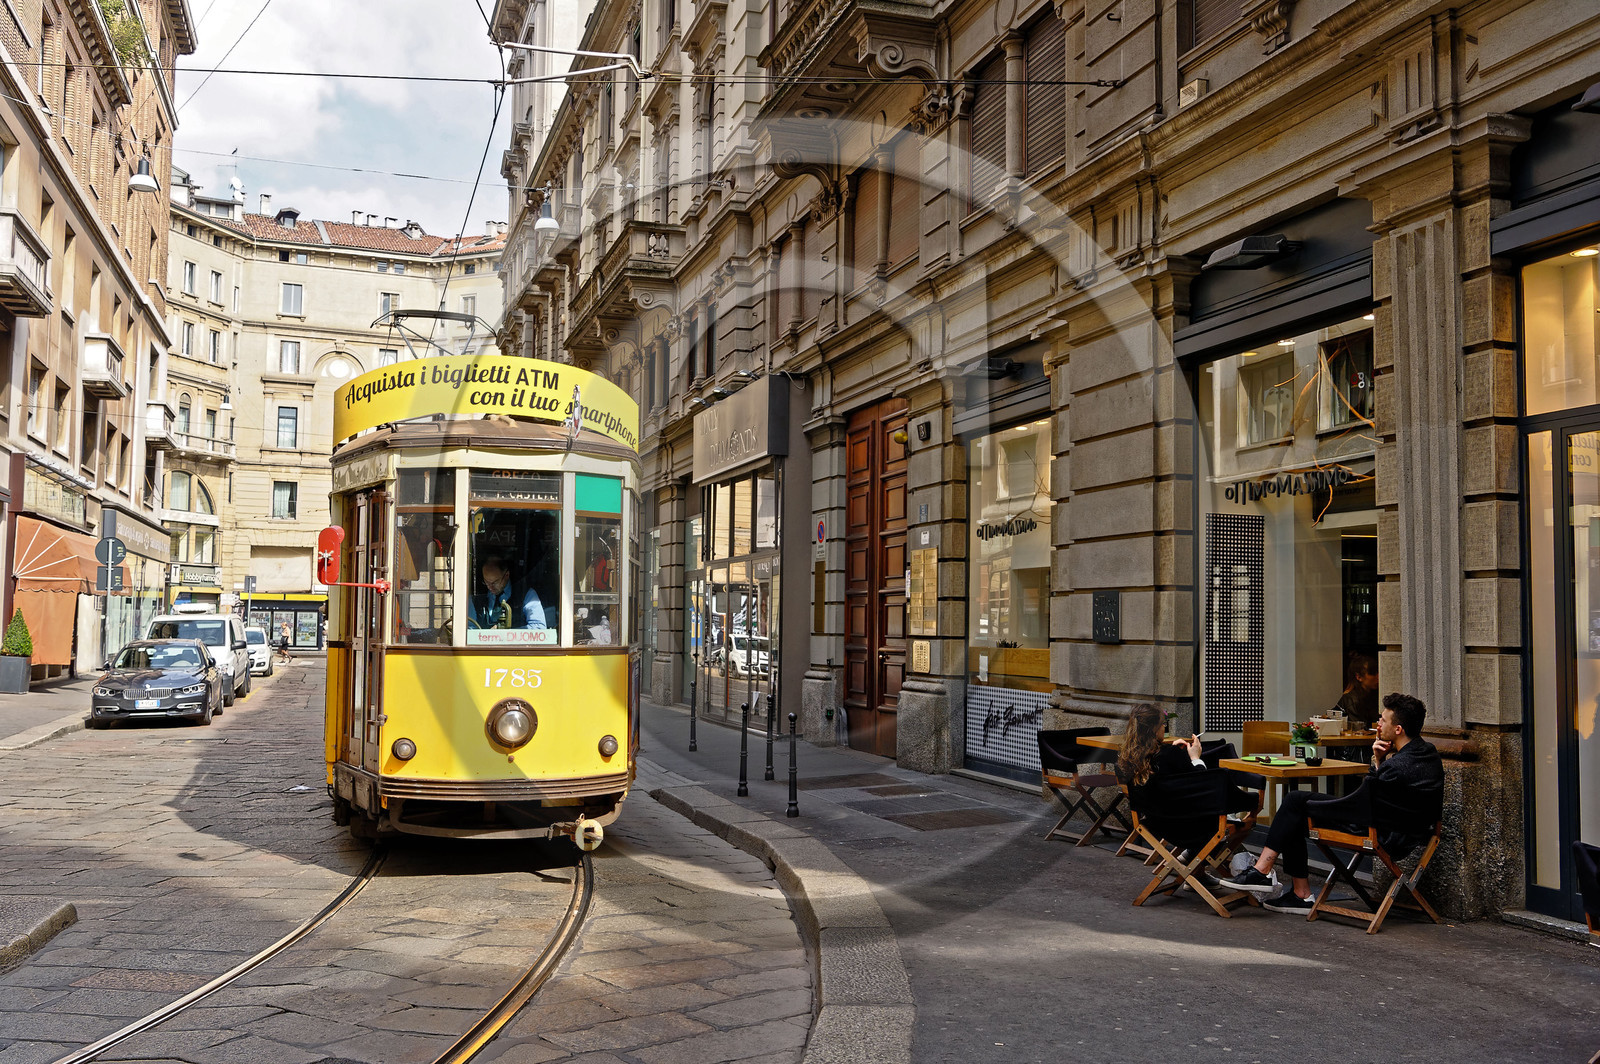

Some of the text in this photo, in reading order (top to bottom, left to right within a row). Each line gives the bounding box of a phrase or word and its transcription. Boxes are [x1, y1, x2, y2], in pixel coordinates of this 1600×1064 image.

[345, 363, 560, 410] Acquista i biglietti ATM
[469, 388, 505, 407] con
[510, 388, 525, 408] il
[529, 391, 561, 412] tuo
[506, 631, 547, 642] DUOMO
[484, 668, 543, 689] 1785
